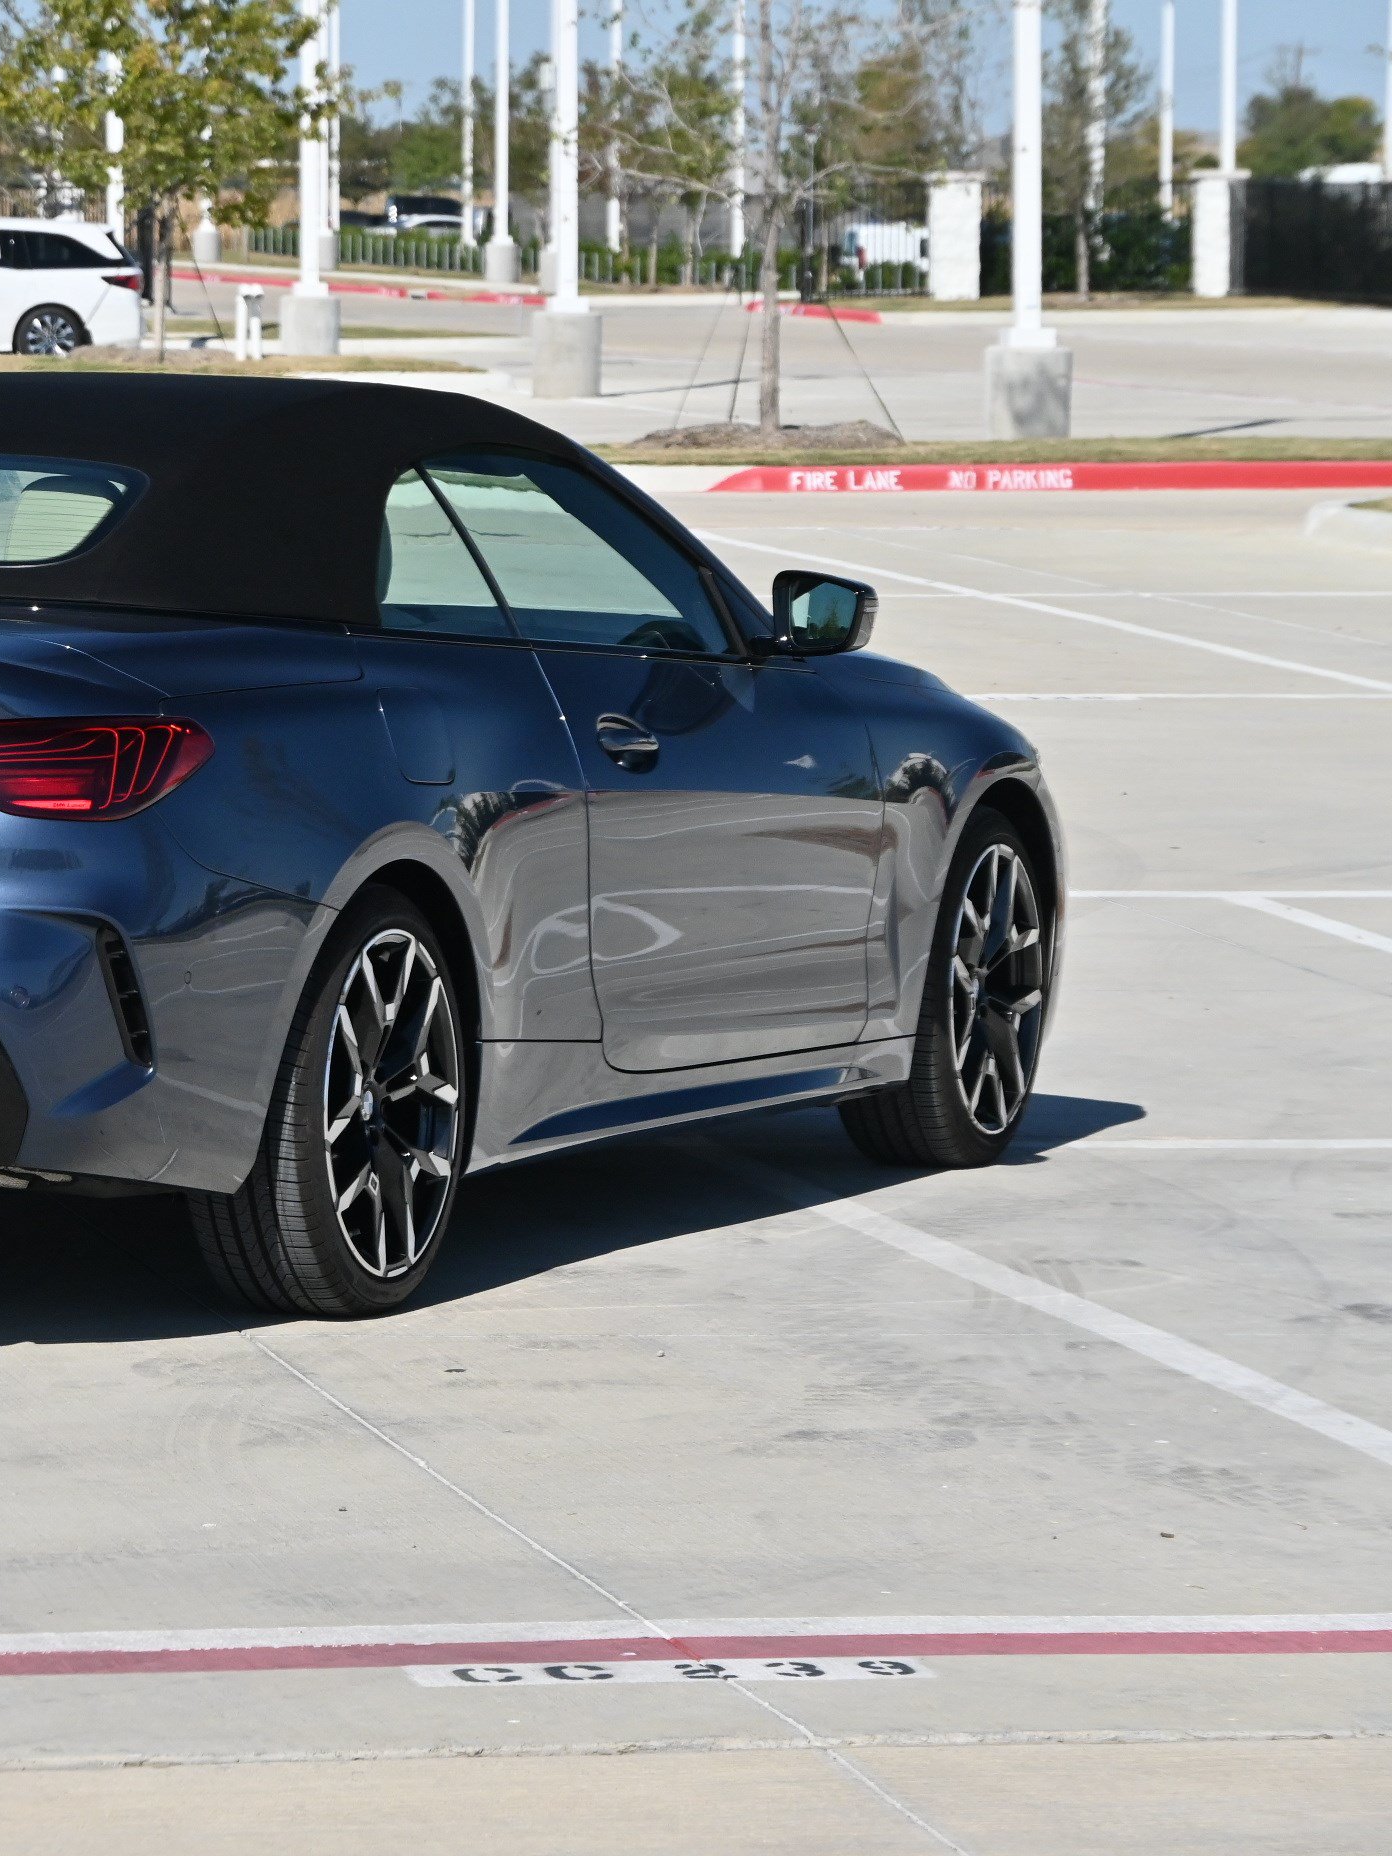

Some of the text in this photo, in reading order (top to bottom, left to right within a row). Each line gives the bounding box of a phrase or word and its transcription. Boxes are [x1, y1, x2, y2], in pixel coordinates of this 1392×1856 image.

[787, 468, 1073, 491] FIRE LANE NO PARKING
